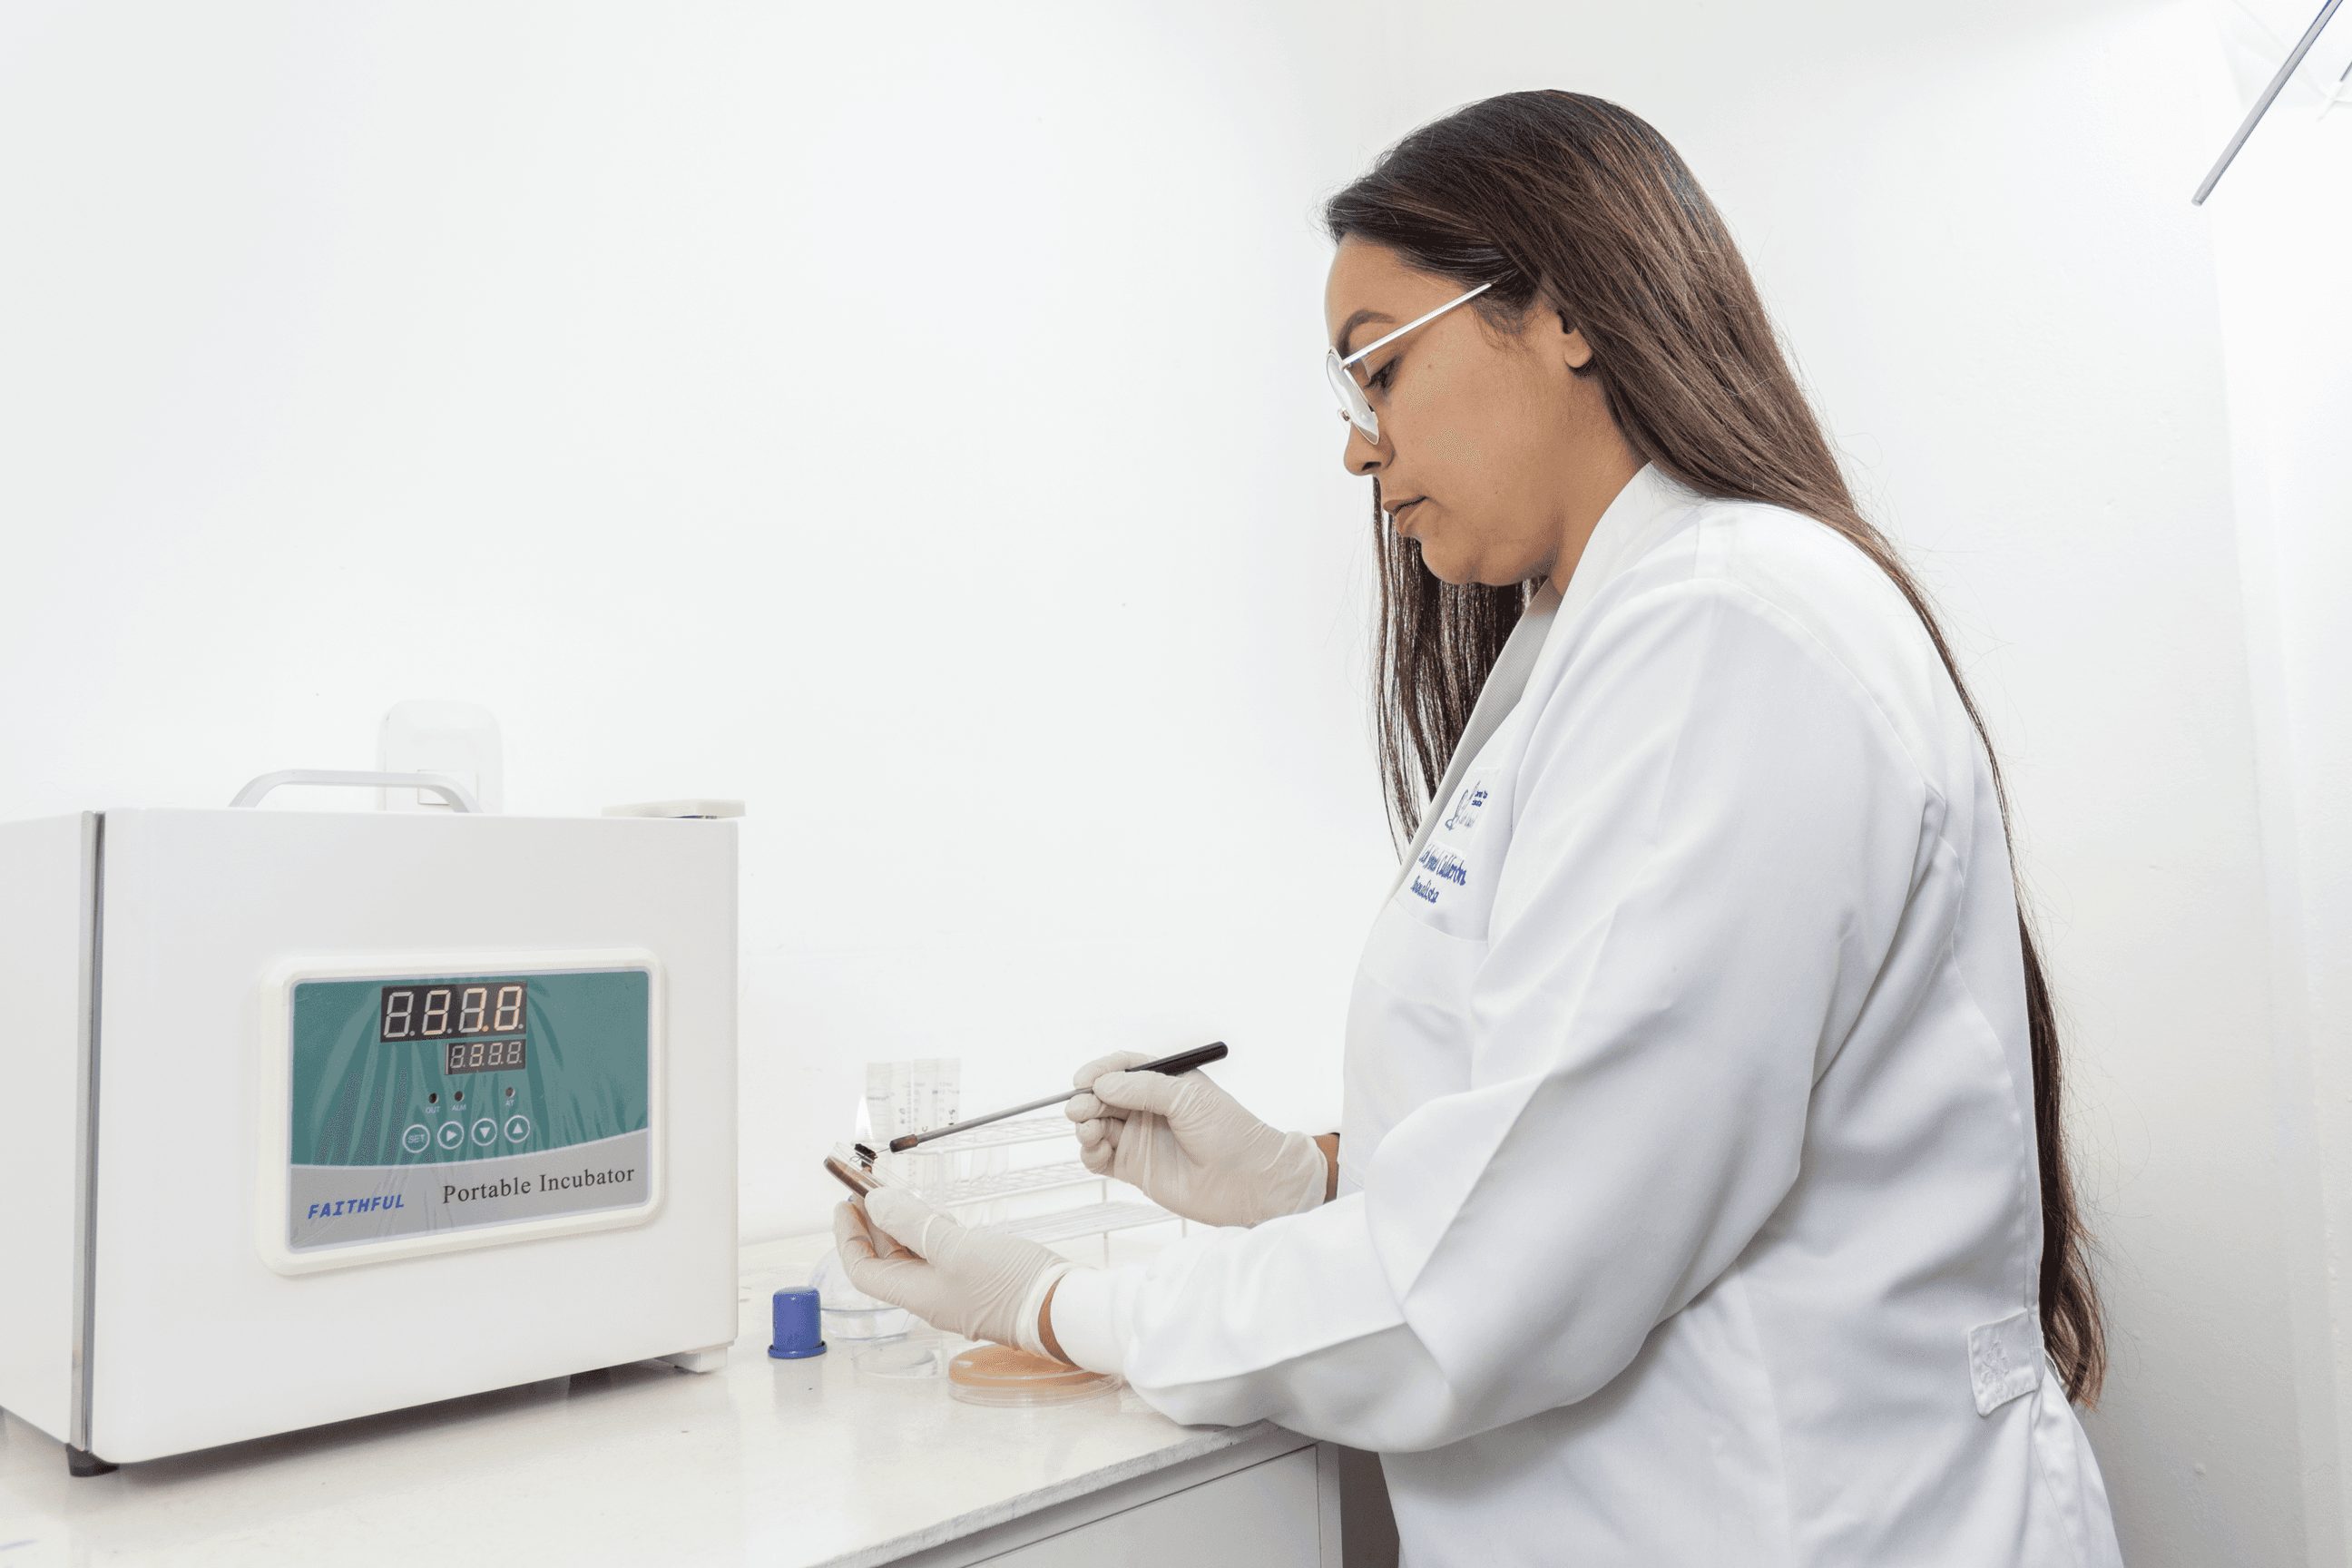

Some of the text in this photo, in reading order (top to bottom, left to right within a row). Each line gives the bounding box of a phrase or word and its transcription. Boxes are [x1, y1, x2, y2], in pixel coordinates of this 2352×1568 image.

[451, 1103, 466, 1112] ALM
[505, 1099, 514, 1107] AT
[425, 1105, 441, 1114] OUT
[407, 1133, 426, 1144] SET
[442, 1168, 635, 1204] Portable Incubator
[308, 1194, 405, 1220] FAITHFUL
